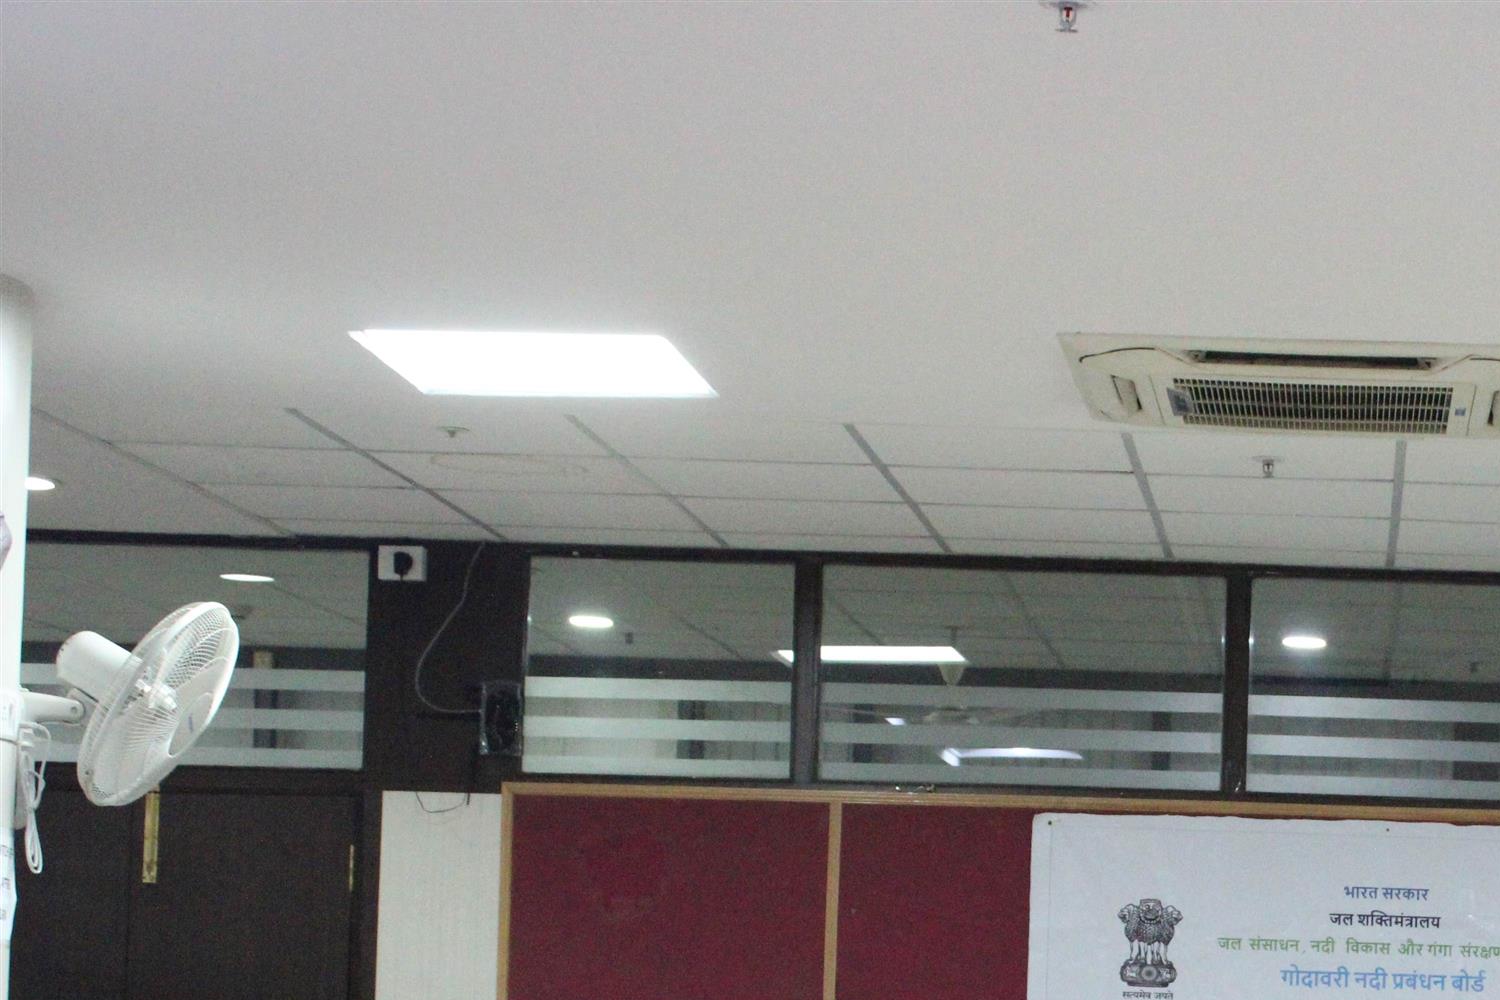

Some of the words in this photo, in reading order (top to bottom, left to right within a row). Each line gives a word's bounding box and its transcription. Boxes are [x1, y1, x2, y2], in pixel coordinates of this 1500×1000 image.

[1344, 886, 1378, 900] भारत
[1382, 887, 1430, 901] सरकार
[1329, 912, 1353, 926] जल
[1217, 937, 1242, 951] जल
[1310, 936, 1336, 953] नदी
[1346, 936, 1391, 956] विकास
[1398, 938, 1423, 957] और
[1428, 940, 1452, 957] गंगा
[1280, 964, 1349, 989] गोदावरी
[1354, 966, 1387, 990] नदी
[1392, 969, 1447, 992] प्रबंधन
[1451, 967, 1487, 993] बोर्ड
